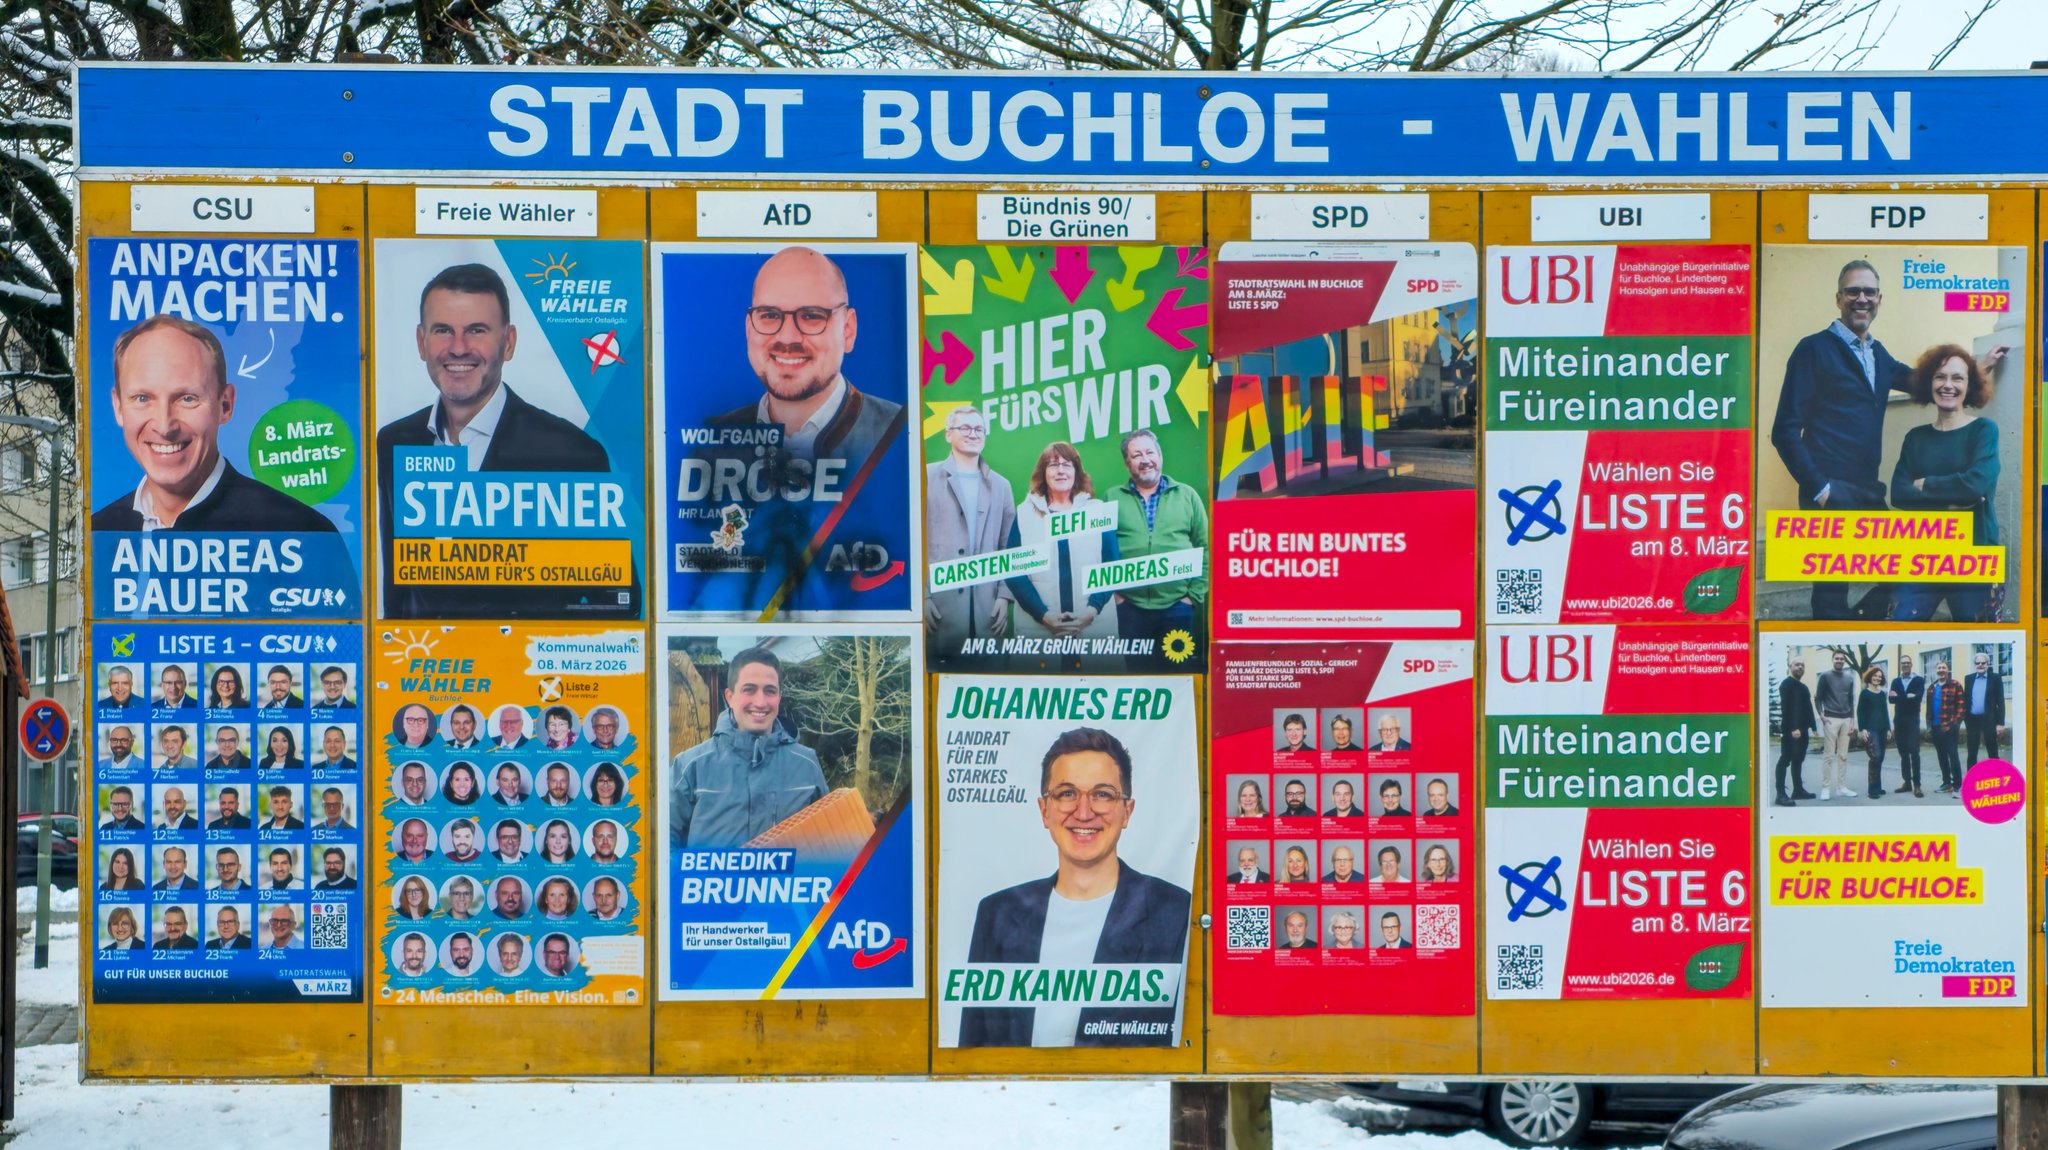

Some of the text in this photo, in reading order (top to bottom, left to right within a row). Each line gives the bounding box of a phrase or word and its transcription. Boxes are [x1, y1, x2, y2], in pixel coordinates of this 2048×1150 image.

[488, 84, 1910, 164] STADT BUCHLOE WAHLEN
[192, 198, 252, 220] CSU
[437, 202, 574, 222] Freie Wähler
[763, 204, 811, 225] AfD
[1004, 197, 1131, 220] Bündnis 90/
[1312, 206, 1368, 228] SPD
[1600, 208, 1642, 226] UBI
[1870, 206, 1925, 228] FDP
[1007, 219, 1128, 238] Die Grünen
[110, 243, 338, 277] ANPACKEN!
[1619, 262, 1749, 272] Unabhängige Bürgerinitiative
[1903, 259, 1945, 273] Freie
[549, 280, 611, 294] FREIE
[1228, 279, 1363, 288] STADTRATSWAHL IN BUCHLOE
[1407, 279, 1438, 293] SPD
[1500, 255, 1594, 305] UBI
[1619, 274, 1726, 284] für Buchloe, Lindenberg
[1903, 275, 2010, 290] Demokraten
[1619, 286, 1745, 296] Honsolgen und Hausen e.V.
[110, 280, 343, 322] MACHEN.
[541, 295, 627, 313] WÄHLER
[1228, 301, 1278, 309] LISTE 5 SPD
[1968, 295, 2007, 309] FDP
[981, 309, 1106, 394] HIER
[1500, 346, 1729, 377] Miteinander
[982, 364, 1171, 444] FÜRS WIR
[1500, 390, 1736, 421] Füreinander
[265, 422, 333, 441] 8. März
[681, 429, 779, 445] WOLFGANG
[258, 445, 346, 466] Landrats-
[405, 457, 455, 472] BERND
[282, 468, 327, 488] wahl
[677, 445, 846, 502] DRÖSE
[1589, 461, 1714, 482] Wählen Sie
[403, 481, 626, 527] STAPFNER
[1582, 494, 1744, 530] LISTE 6
[1051, 511, 1111, 536] ELFI Klein
[1775, 517, 1965, 540] FREIE STIMME.
[1228, 529, 1406, 553] FÜR EIN BUNTES
[1631, 536, 1749, 556] am 8. März
[111, 538, 303, 573] ANDREAS
[400, 543, 528, 562] IHR LANDRAT
[825, 541, 889, 572] AfD
[1011, 549, 1038, 560] Rösnick-
[399, 563, 622, 581] GEMEINSAM OSTALLGÄU
[934, 554, 1010, 586] CARSTEN
[1011, 559, 1048, 571] Neugebauer
[1087, 557, 1169, 589] ANDREAS
[1228, 558, 1339, 577] BUCHLOE!
[1801, 553, 1998, 576] STARKE STADT!
[114, 578, 249, 613] BAUER
[269, 588, 322, 606] CSU
[1567, 597, 1673, 609] www.ubi2026.de
[159, 635, 311, 654] LISTE 1 CSU
[962, 636, 1154, 655] AM 8. MÄRZ GRÜNE WÄHLEN!
[409, 659, 475, 674] FREIE
[538, 660, 627, 671] 08. März 2026
[1403, 660, 1434, 673] SPD
[1500, 634, 1593, 683] UBI
[400, 674, 491, 692] WÄHLER
[566, 682, 599, 691] Liste 2
[429, 694, 462, 702] Buchloe
[947, 687, 1172, 720] JOHANNES ERD
[99, 709, 106, 718] 1
[947, 731, 1010, 745] LANDRAT
[1499, 724, 1729, 754] Miteinander
[947, 747, 998, 765] FÜR EIN
[312, 770, 324, 779] 10
[947, 769, 1007, 784] STARKES
[1499, 767, 1735, 798] Füreinander
[1976, 776, 2010, 790] LISTE 7
[947, 786, 1027, 803] OSTALLGÄU.
[1971, 792, 2021, 809] WÄHLEN!
[258, 830, 272, 840] 14
[681, 852, 792, 871] BENEDIKT
[1779, 841, 1950, 863] GEMEINSAM
[682, 877, 832, 904] BRUNNER
[1779, 870, 1976, 899] FÜR BUCHLOE.
[686, 926, 764, 934] Ihr Handwerker
[828, 920, 891, 949] AfD
[686, 937, 701, 946] für
[735, 937, 787, 947] Ostallgäu!
[258, 950, 272, 960] 24
[105, 968, 228, 979] GUT FÜR UNSER BUCHLOE
[303, 981, 348, 992] 8. MÄRZ
[944, 969, 1169, 1002] ERD KANN DAS.
[396, 990, 608, 1004] 24 Menschen. Eine Vision.
[1084, 1021, 1168, 1035] GRÜNE WÄHLEN!
